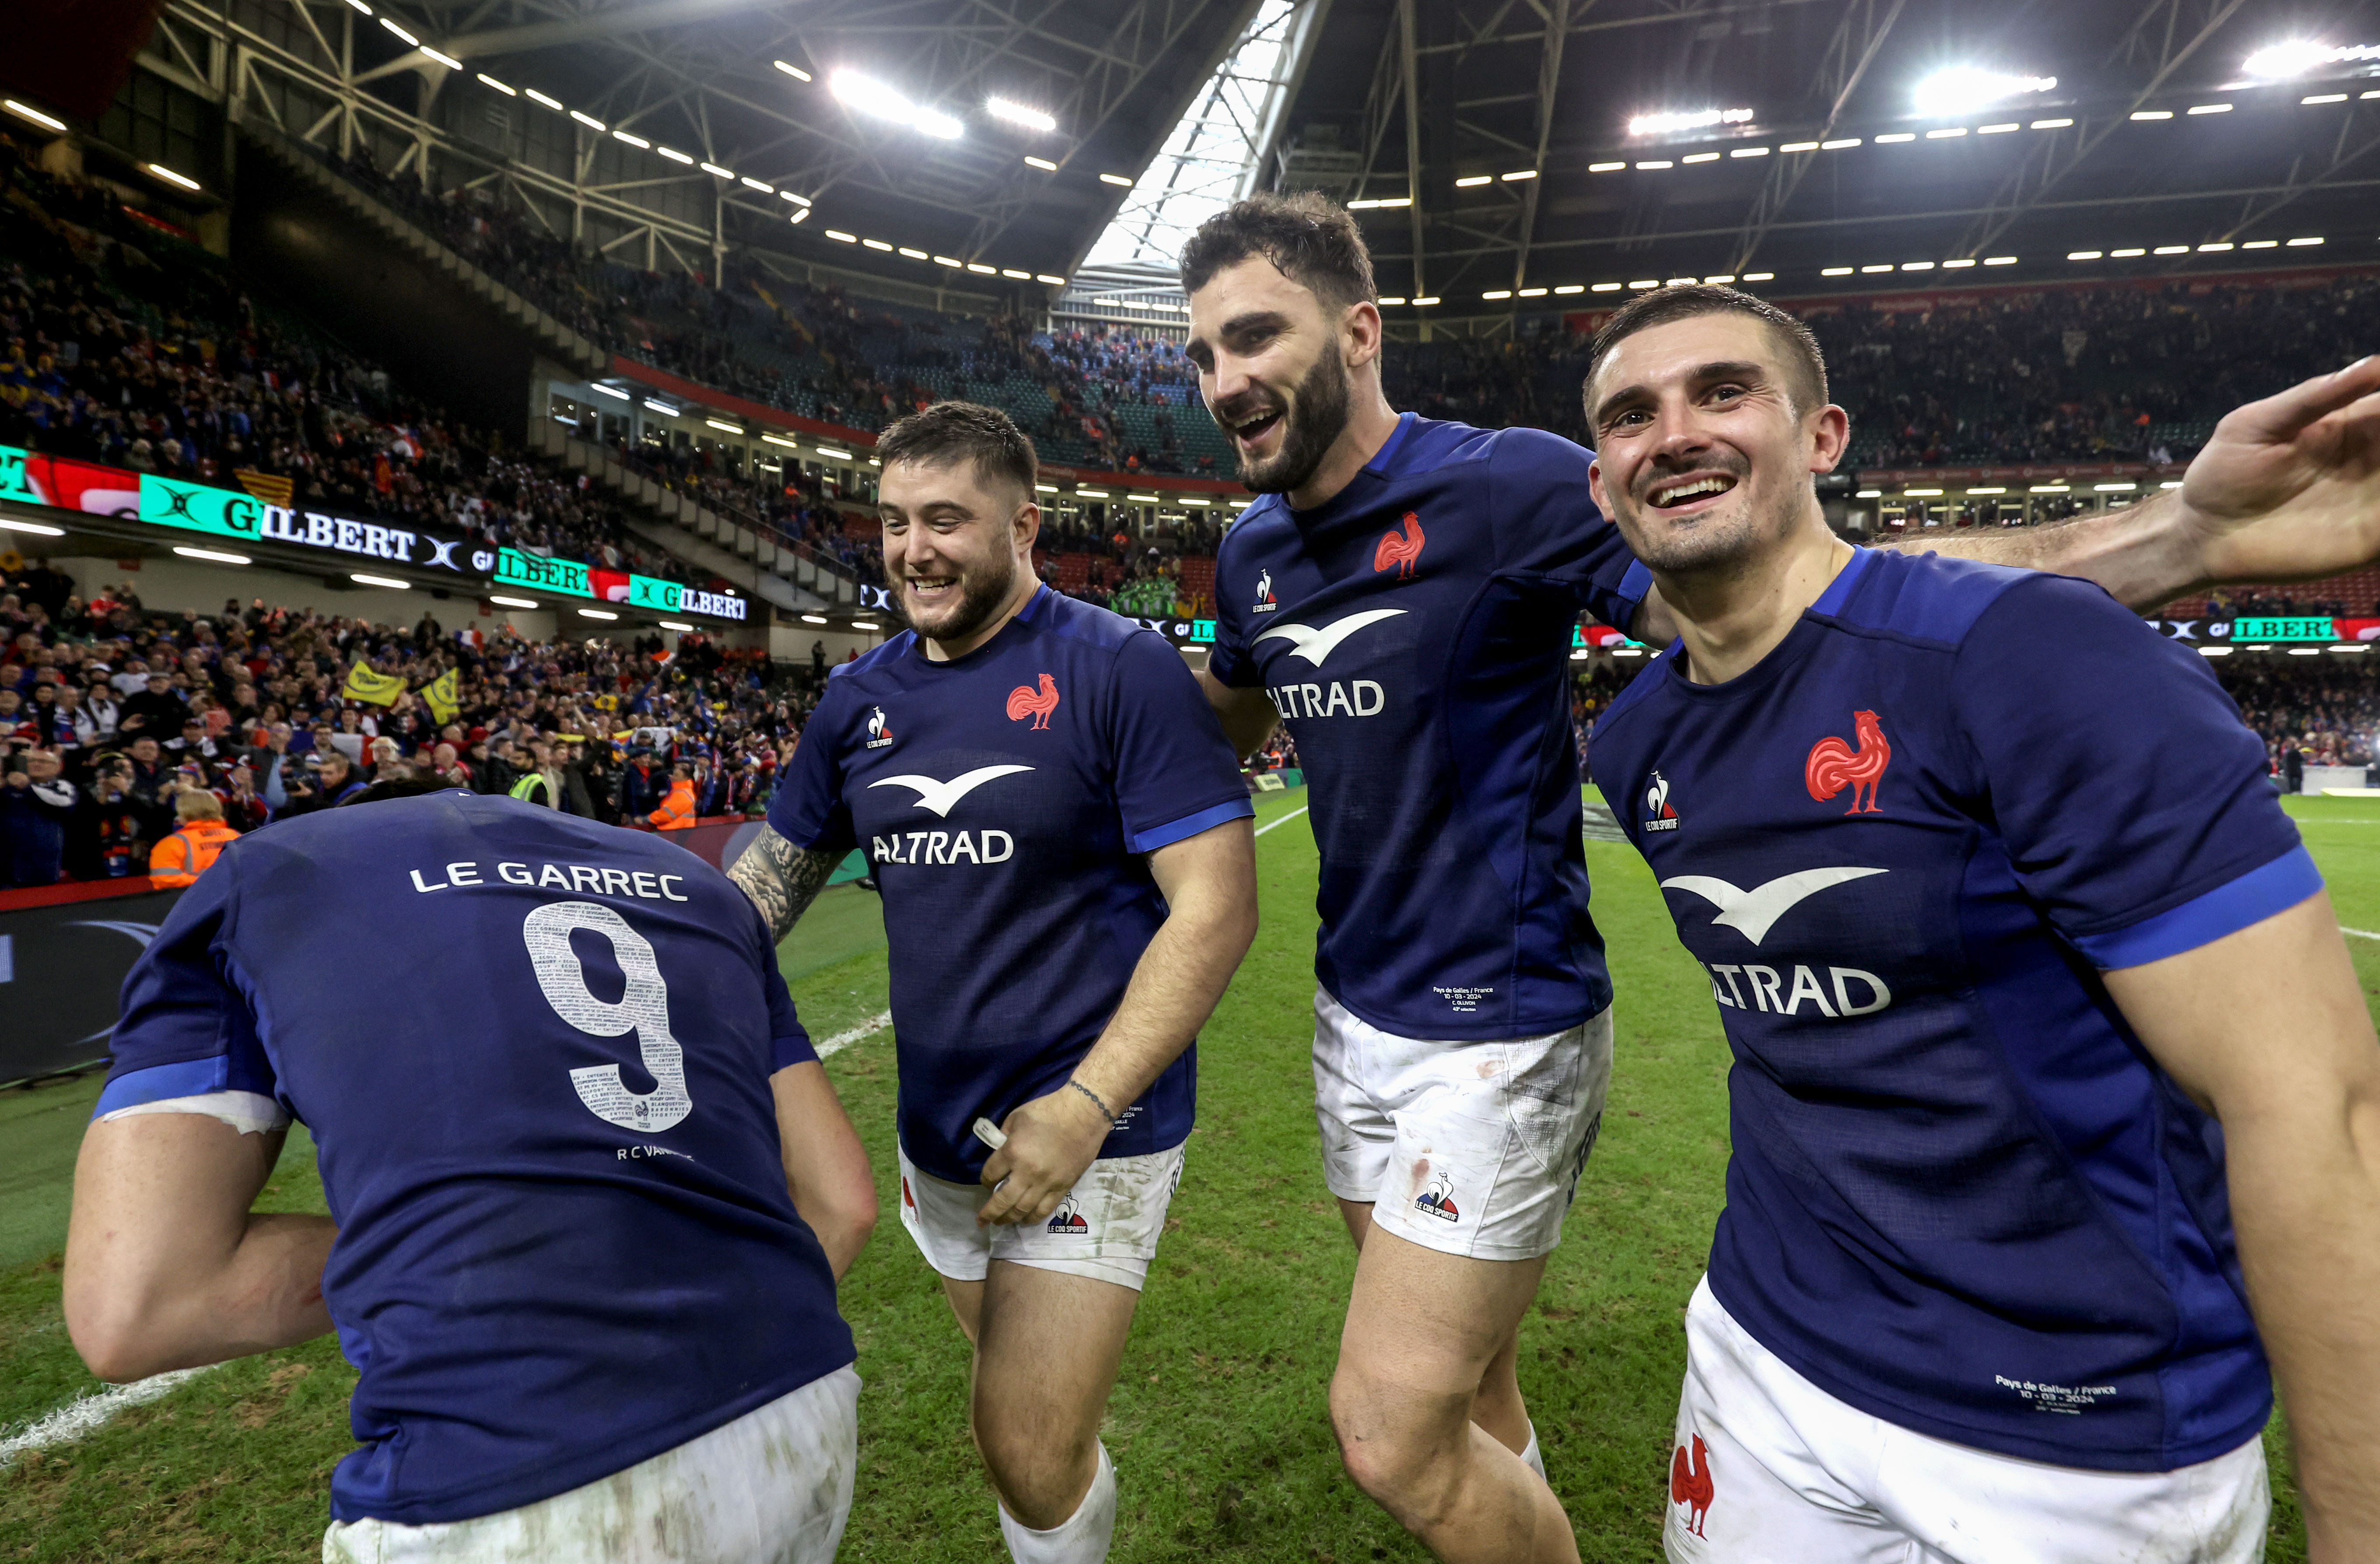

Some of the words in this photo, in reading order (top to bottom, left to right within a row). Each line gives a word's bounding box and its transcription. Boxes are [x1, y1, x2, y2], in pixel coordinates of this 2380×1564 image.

[224, 499, 416, 562] GILBERT
[663, 585, 746, 620] GILBERT
[1646, 822, 1651, 831] LE
[1651, 821, 1659, 830] COQ
[1659, 819, 1677, 830] SPORTIF
[873, 829, 1014, 865] ALTRAD
[409, 861, 483, 893] LE
[497, 861, 688, 902] GARREC
[1699, 960, 1891, 1017] LTRAD
[523, 901, 693, 1133] 9
[617, 1148, 627, 1160] R
[631, 1146, 641, 1158] C
[1415, 1200, 1423, 1209] LE
[1422, 1203, 1434, 1213] COQ
[1434, 1207, 1458, 1221] SPORTIF
[1995, 1374, 2022, 1390] Pays
[2023, 1381, 2037, 1392] de
[2038, 1383, 2072, 1395] Galles
[2081, 1386, 2117, 1395] France
